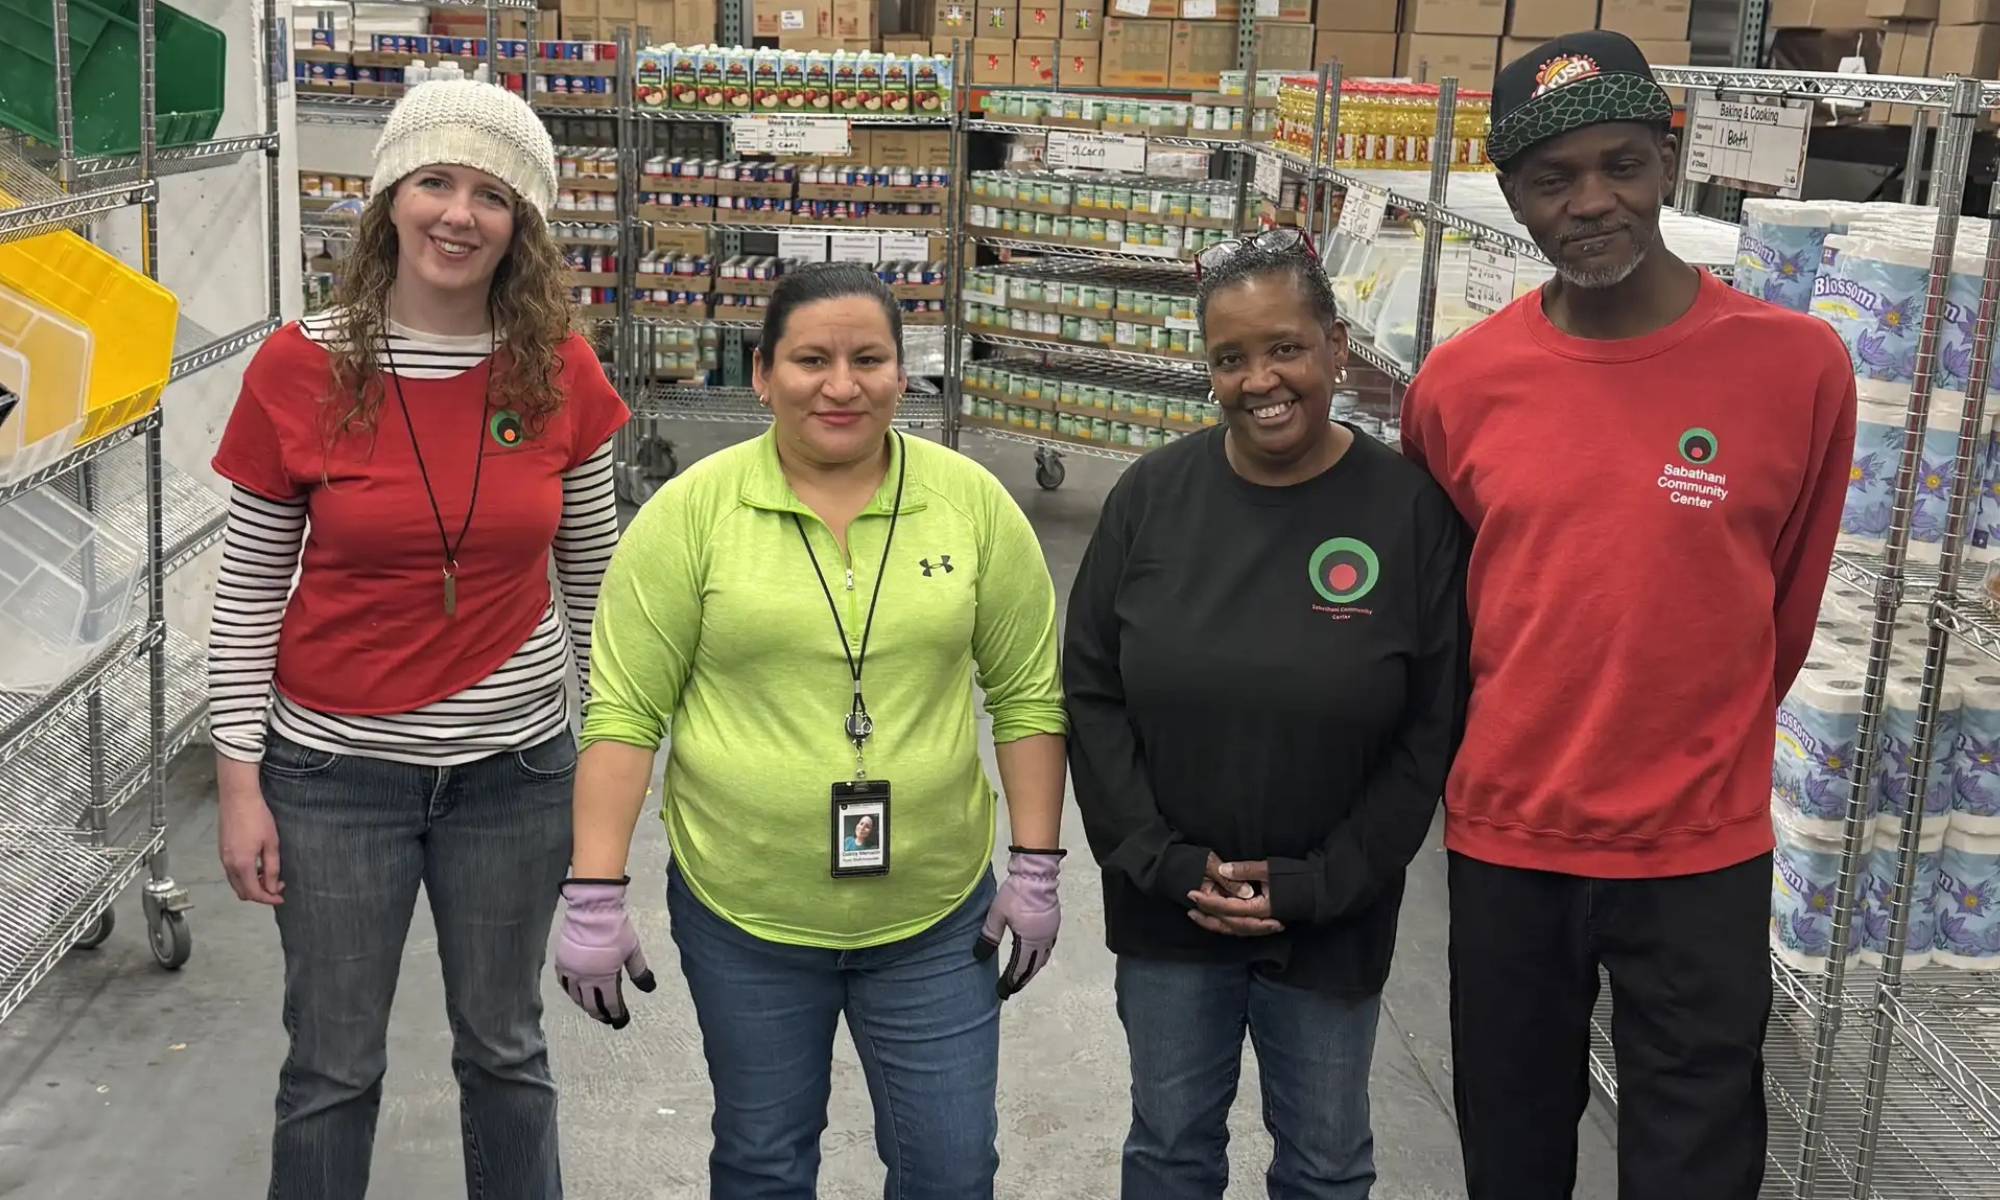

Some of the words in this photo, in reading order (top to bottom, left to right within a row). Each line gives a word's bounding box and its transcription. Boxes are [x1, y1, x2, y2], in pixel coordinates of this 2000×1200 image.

[1720, 103, 1742, 122] Baking
[1743, 106, 1749, 119] &
[1750, 106, 1779, 125] Cooking
[1813, 274, 1876, 311] Blossom
[1663, 463, 1726, 485] Sabathani
[1657, 476, 1728, 501] Community
[1670, 491, 1713, 509] Center
[1777, 706, 1816, 755] lossom
